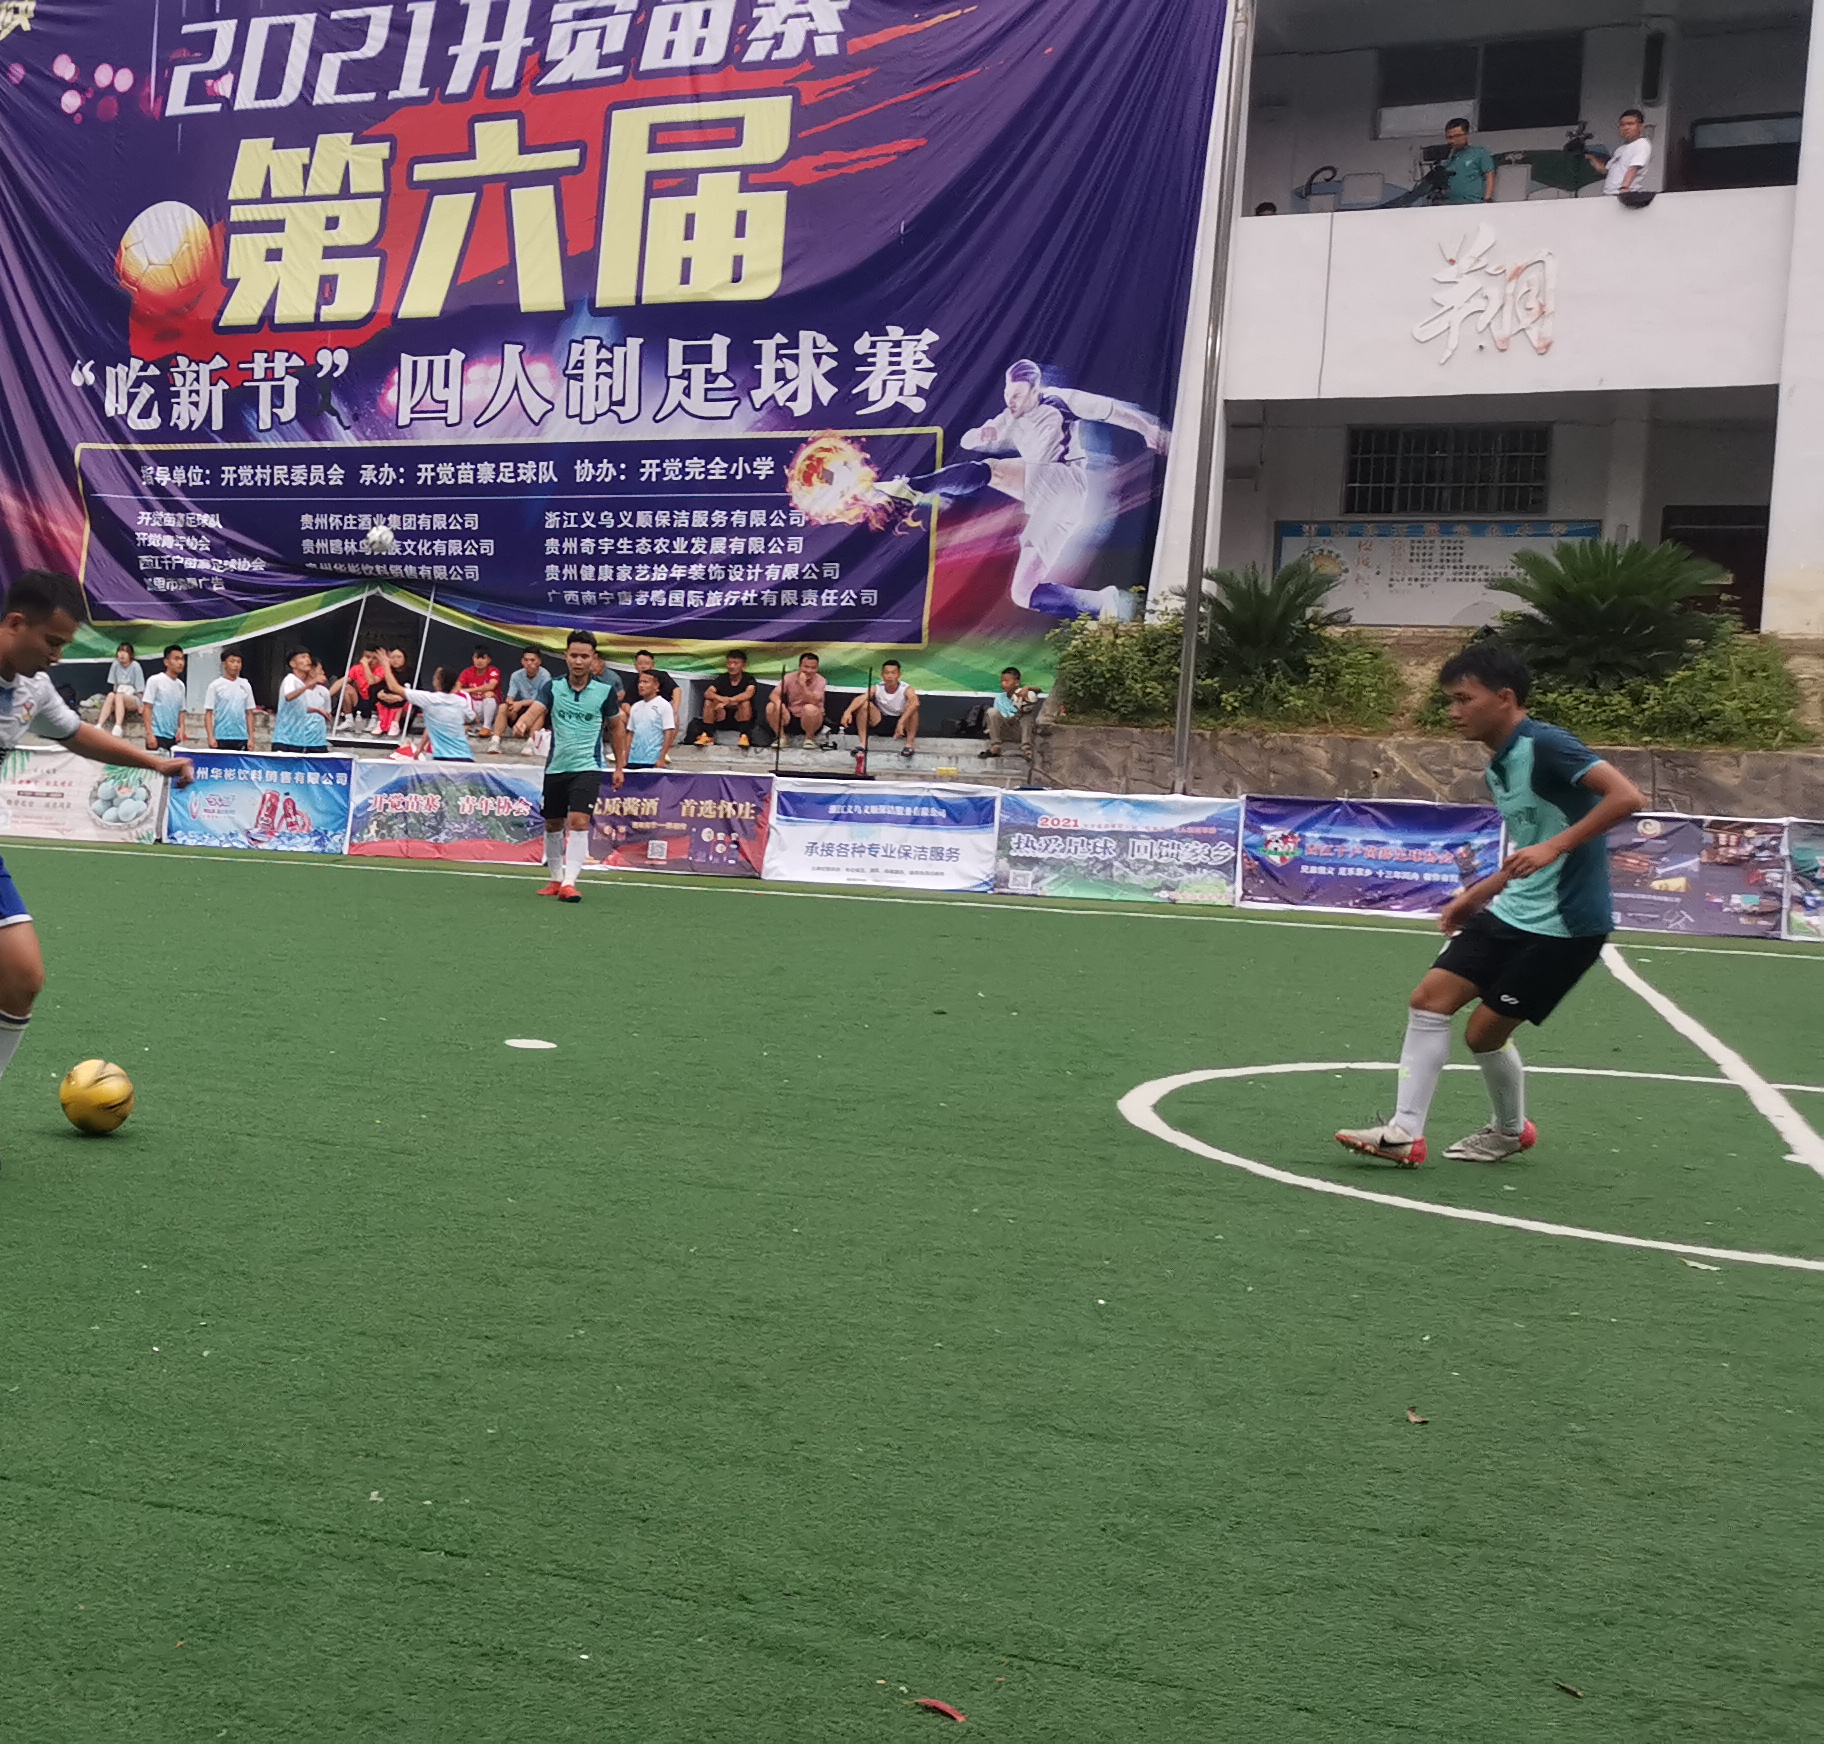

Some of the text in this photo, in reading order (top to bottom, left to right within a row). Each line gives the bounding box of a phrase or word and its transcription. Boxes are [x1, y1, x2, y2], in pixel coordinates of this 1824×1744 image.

[218, 95, 793, 327] 第六届
[1412, 222, 1557, 366] 翔
[396, 326, 940, 427] 四人制足球赛
[300, 513, 479, 530] 贵州怀庄酒业集团有限公司
[545, 510, 806, 529] 浙江义乌义顺保洁服务有限公司
[545, 537, 803, 555] 贵州奇宇生态农业发展有限公司
[545, 562, 840, 582] 贵州健康家艺拾年装饰设计有限公司
[196, 767, 348, 786] 州华彬饮料销售有限公司
[367, 793, 533, 816] 开觉苗寨 青年协会
[680, 798, 756, 820] 首选怀庄
[1038, 816, 1080, 829] 2021
[804, 841, 961, 863] 承接各种专业保洁服务
